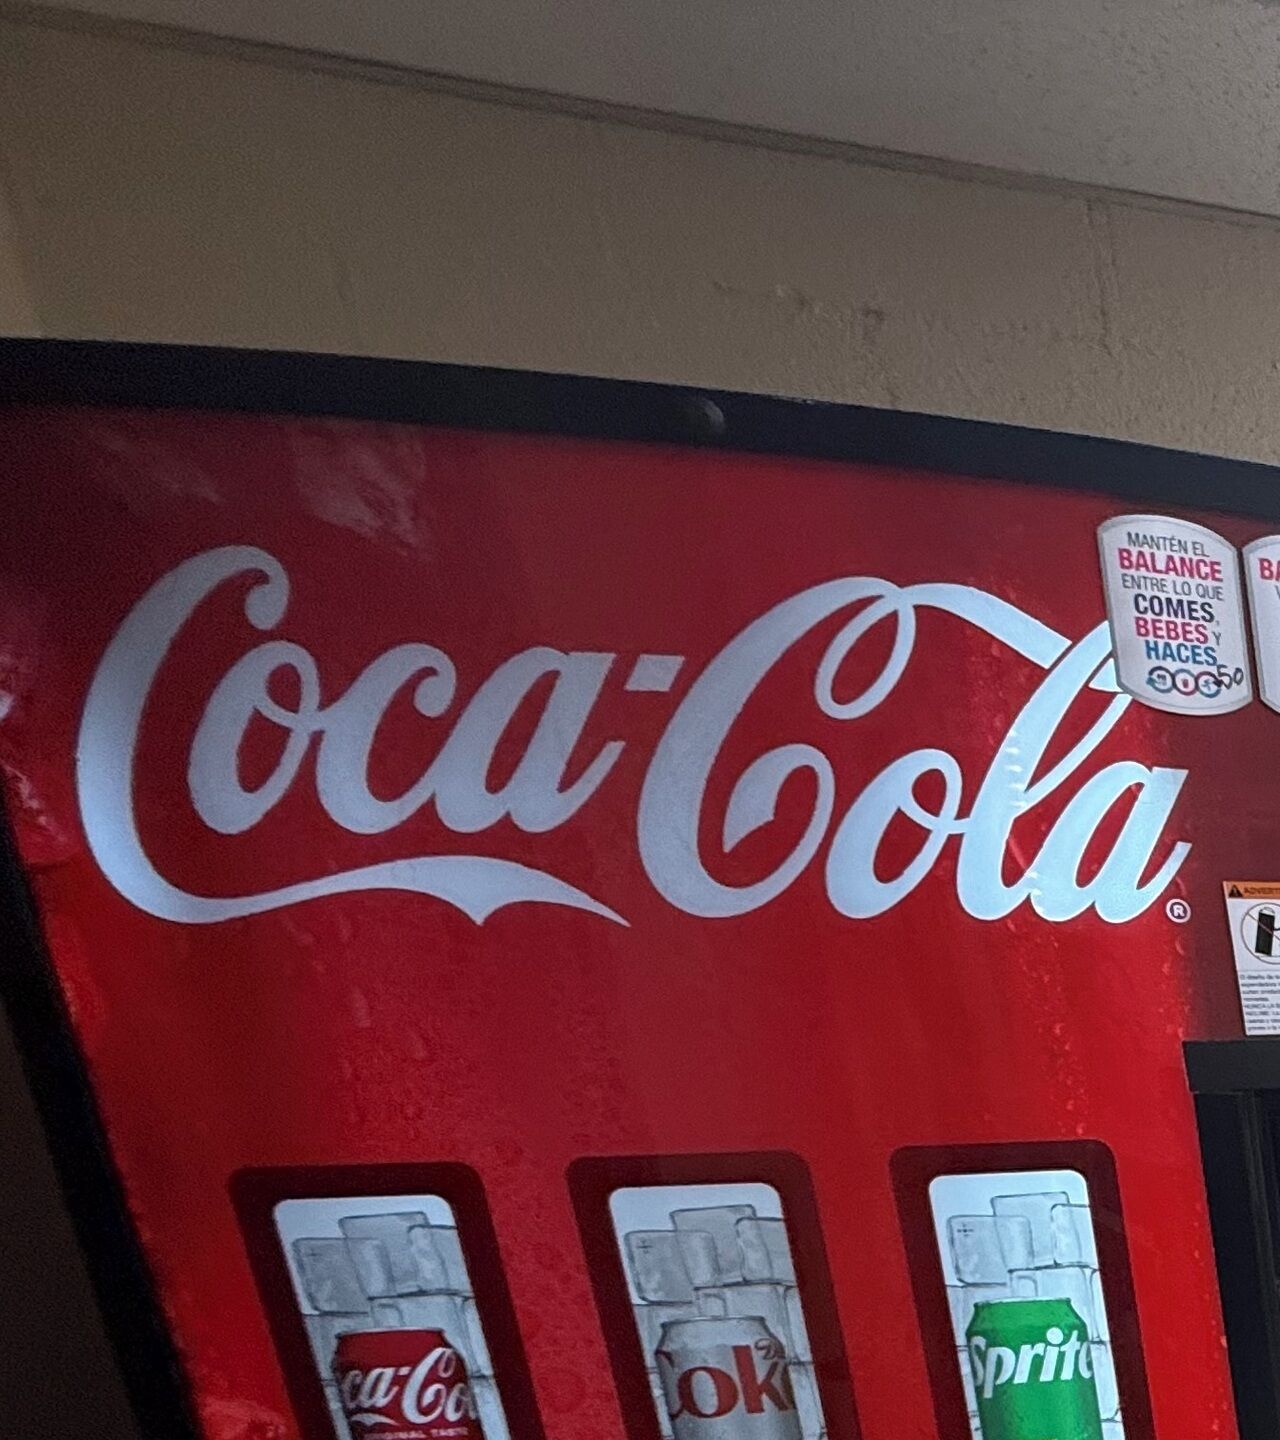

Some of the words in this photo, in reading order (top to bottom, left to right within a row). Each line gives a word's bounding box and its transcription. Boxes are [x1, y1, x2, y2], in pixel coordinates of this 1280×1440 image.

[1127, 531, 1189, 554] MANTÉN
[1192, 541, 1210, 557] EL
[1118, 548, 1223, 582] BALANCE
[1122, 574, 1168, 593] ENTRE
[1173, 581, 1192, 596] LO
[1196, 584, 1224, 601] QUE
[1134, 594, 1220, 625] COMES,
[1136, 616, 1208, 644] BEBES
[1212, 632, 1222, 646] Y
[1145, 640, 1218, 666] HACES
[75, 543, 1192, 926] Coca-Cola
